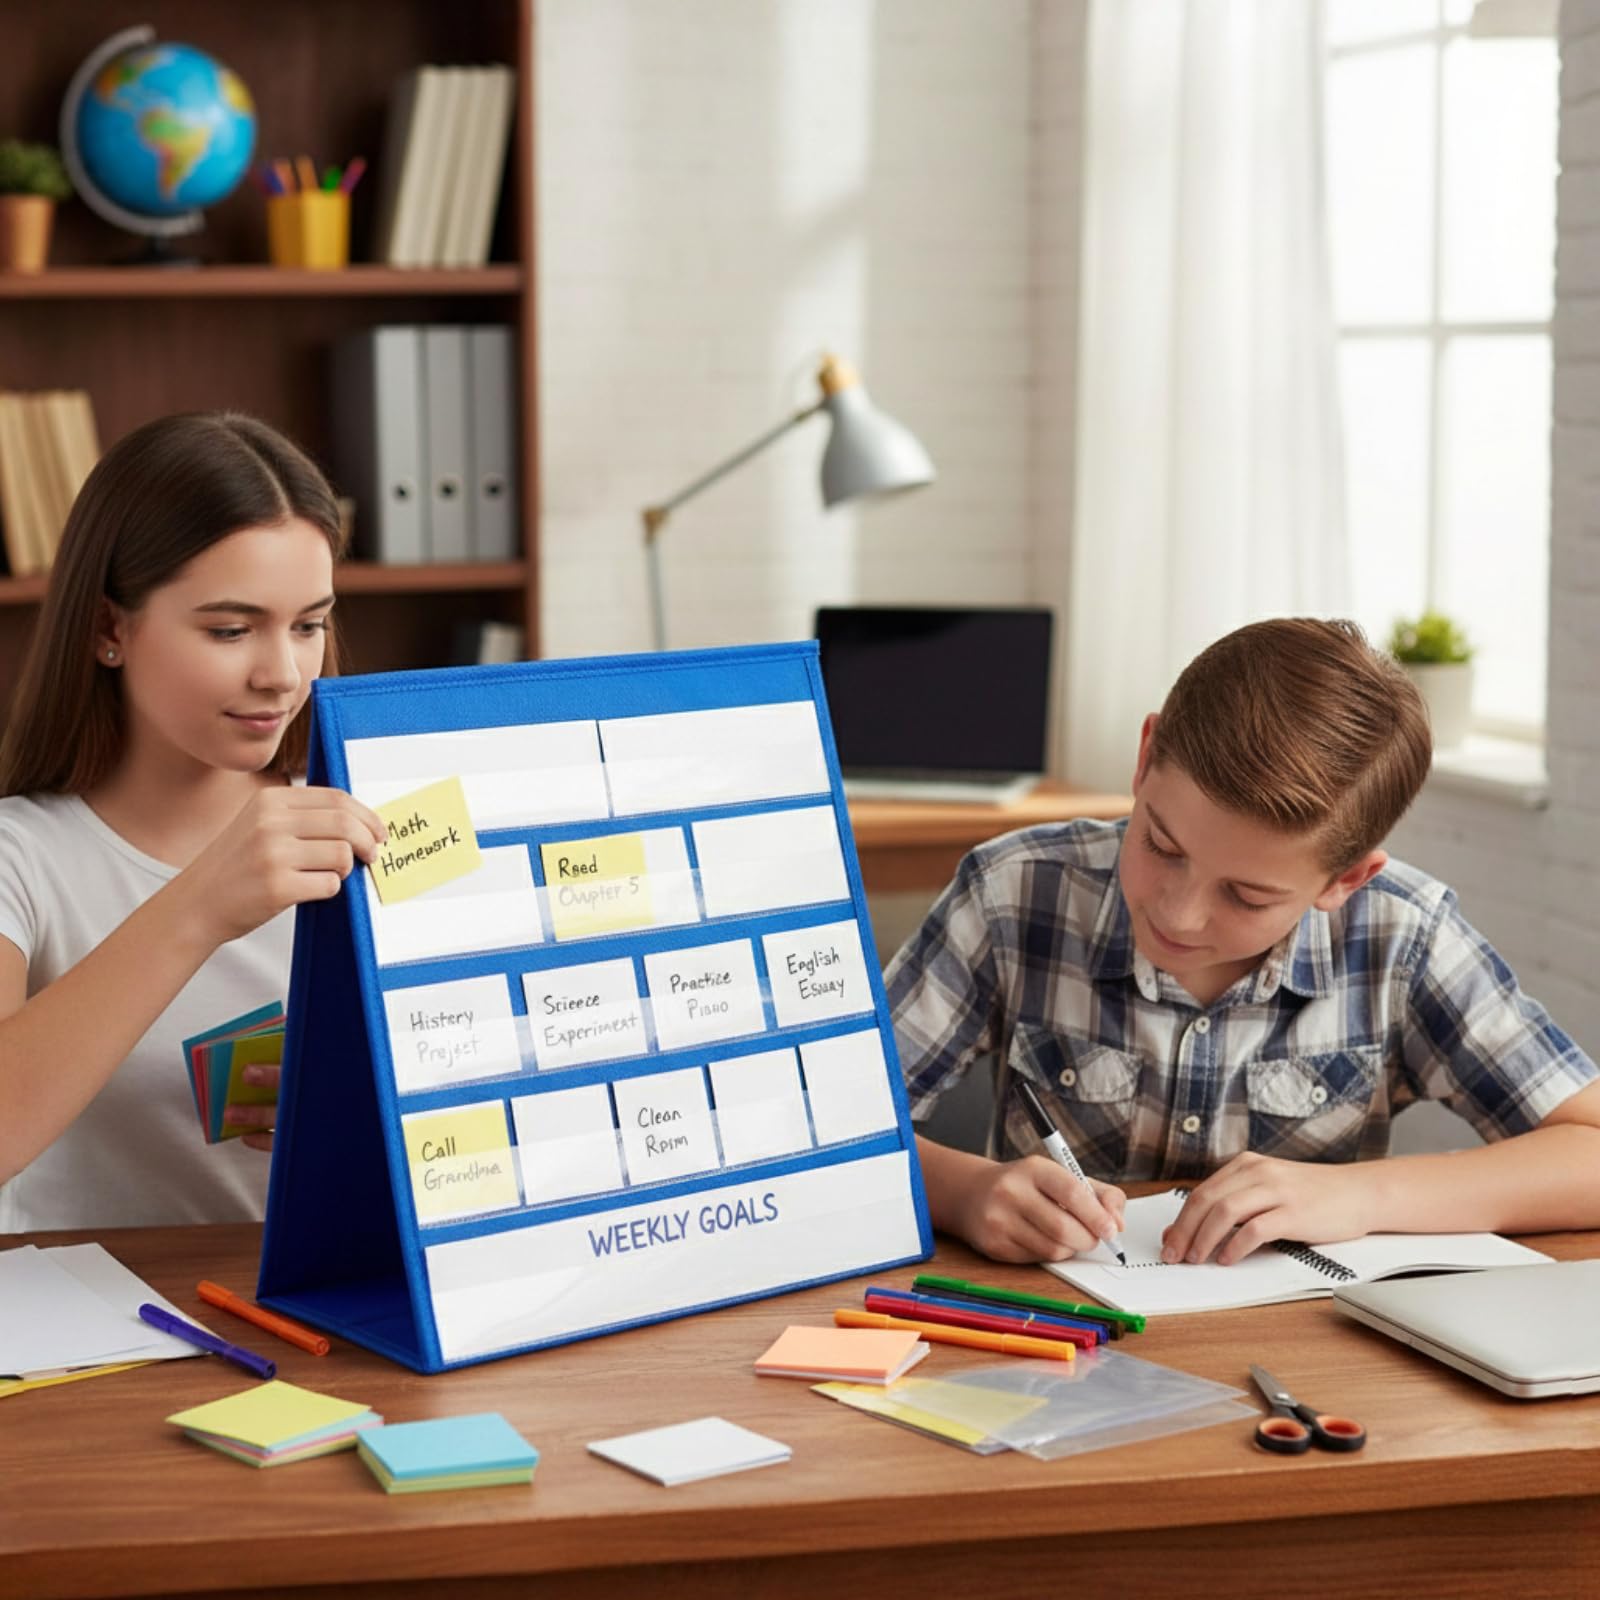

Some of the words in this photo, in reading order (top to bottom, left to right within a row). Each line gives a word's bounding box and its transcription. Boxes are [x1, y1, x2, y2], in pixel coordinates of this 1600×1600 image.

[629, 875, 640, 895] 5
[637, 1107, 682, 1128] Clean
[421, 1136, 457, 1162] Call
[587, 1210, 690, 1257] WEEKLY
[699, 1192, 779, 1234] GOALS
